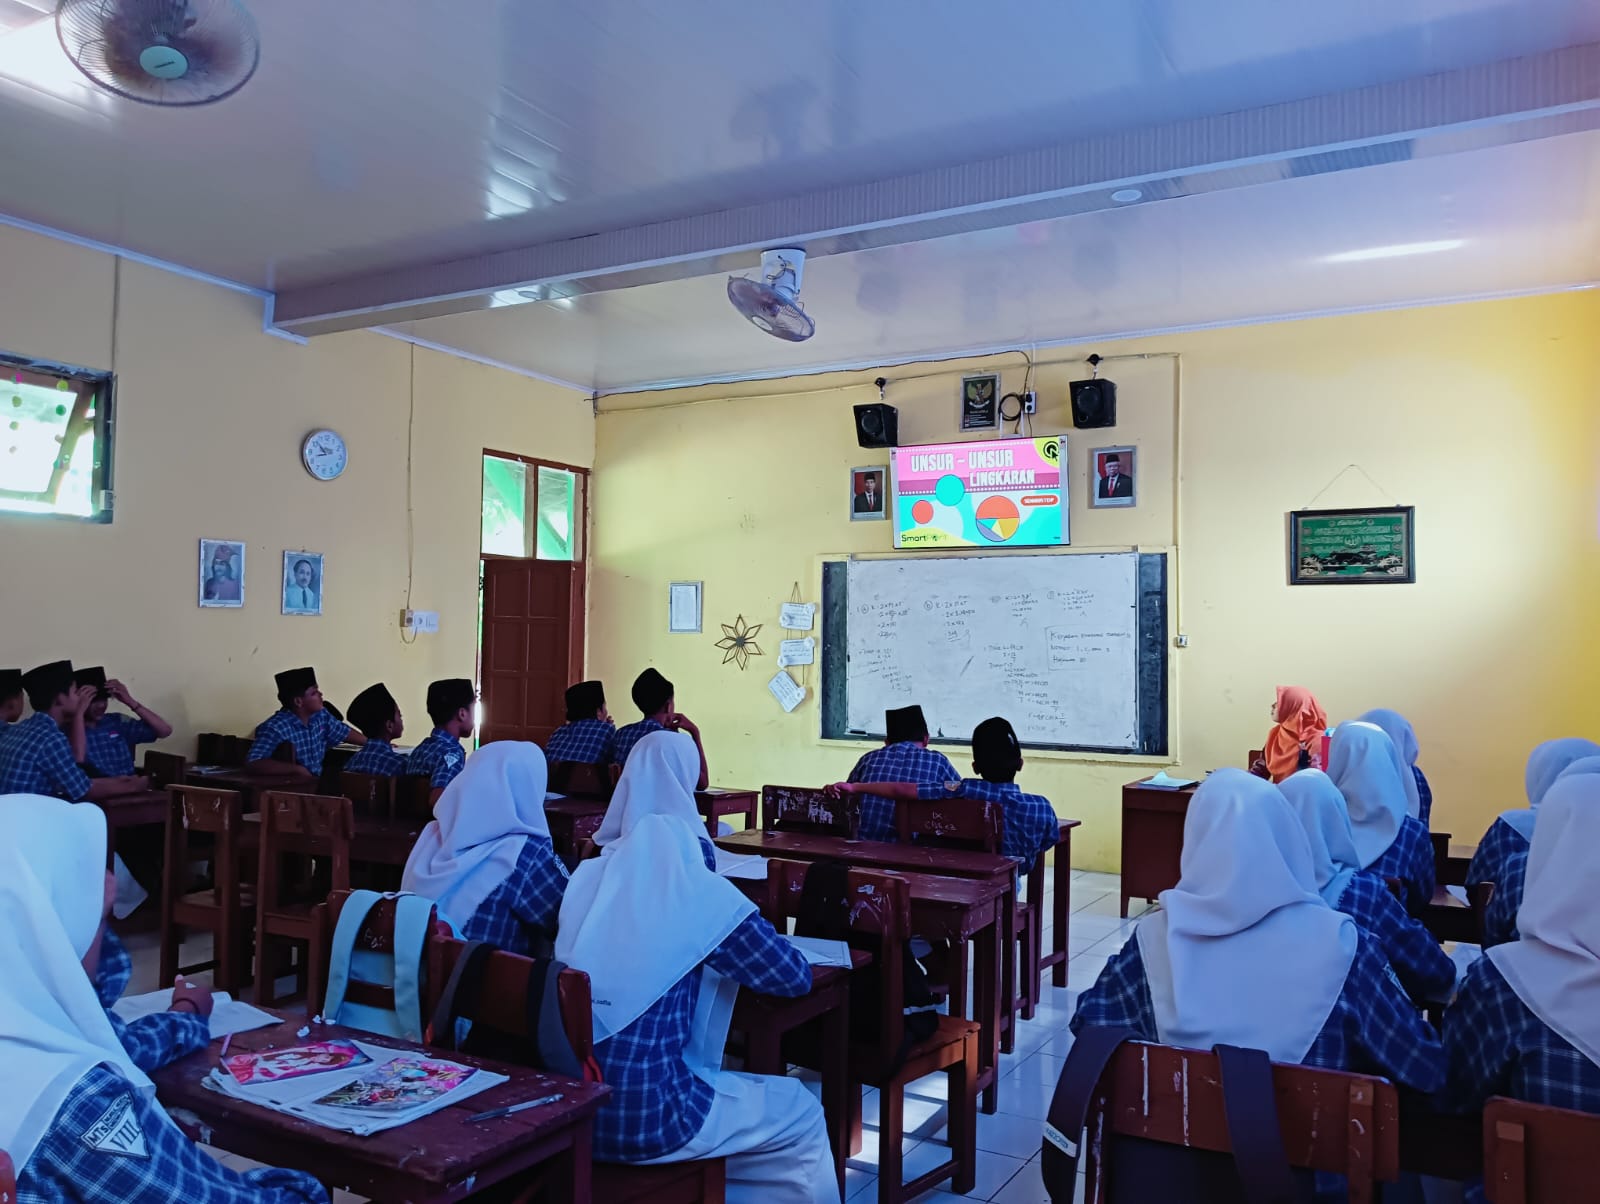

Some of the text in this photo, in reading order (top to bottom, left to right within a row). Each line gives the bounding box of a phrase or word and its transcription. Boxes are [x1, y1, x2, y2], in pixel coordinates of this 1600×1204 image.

[911, 453, 955, 472] UNSUR
[968, 449, 1014, 469] UNSUR
[969, 469, 1036, 487] LINGKARAN
[110, 1120, 140, 1151] VIII
